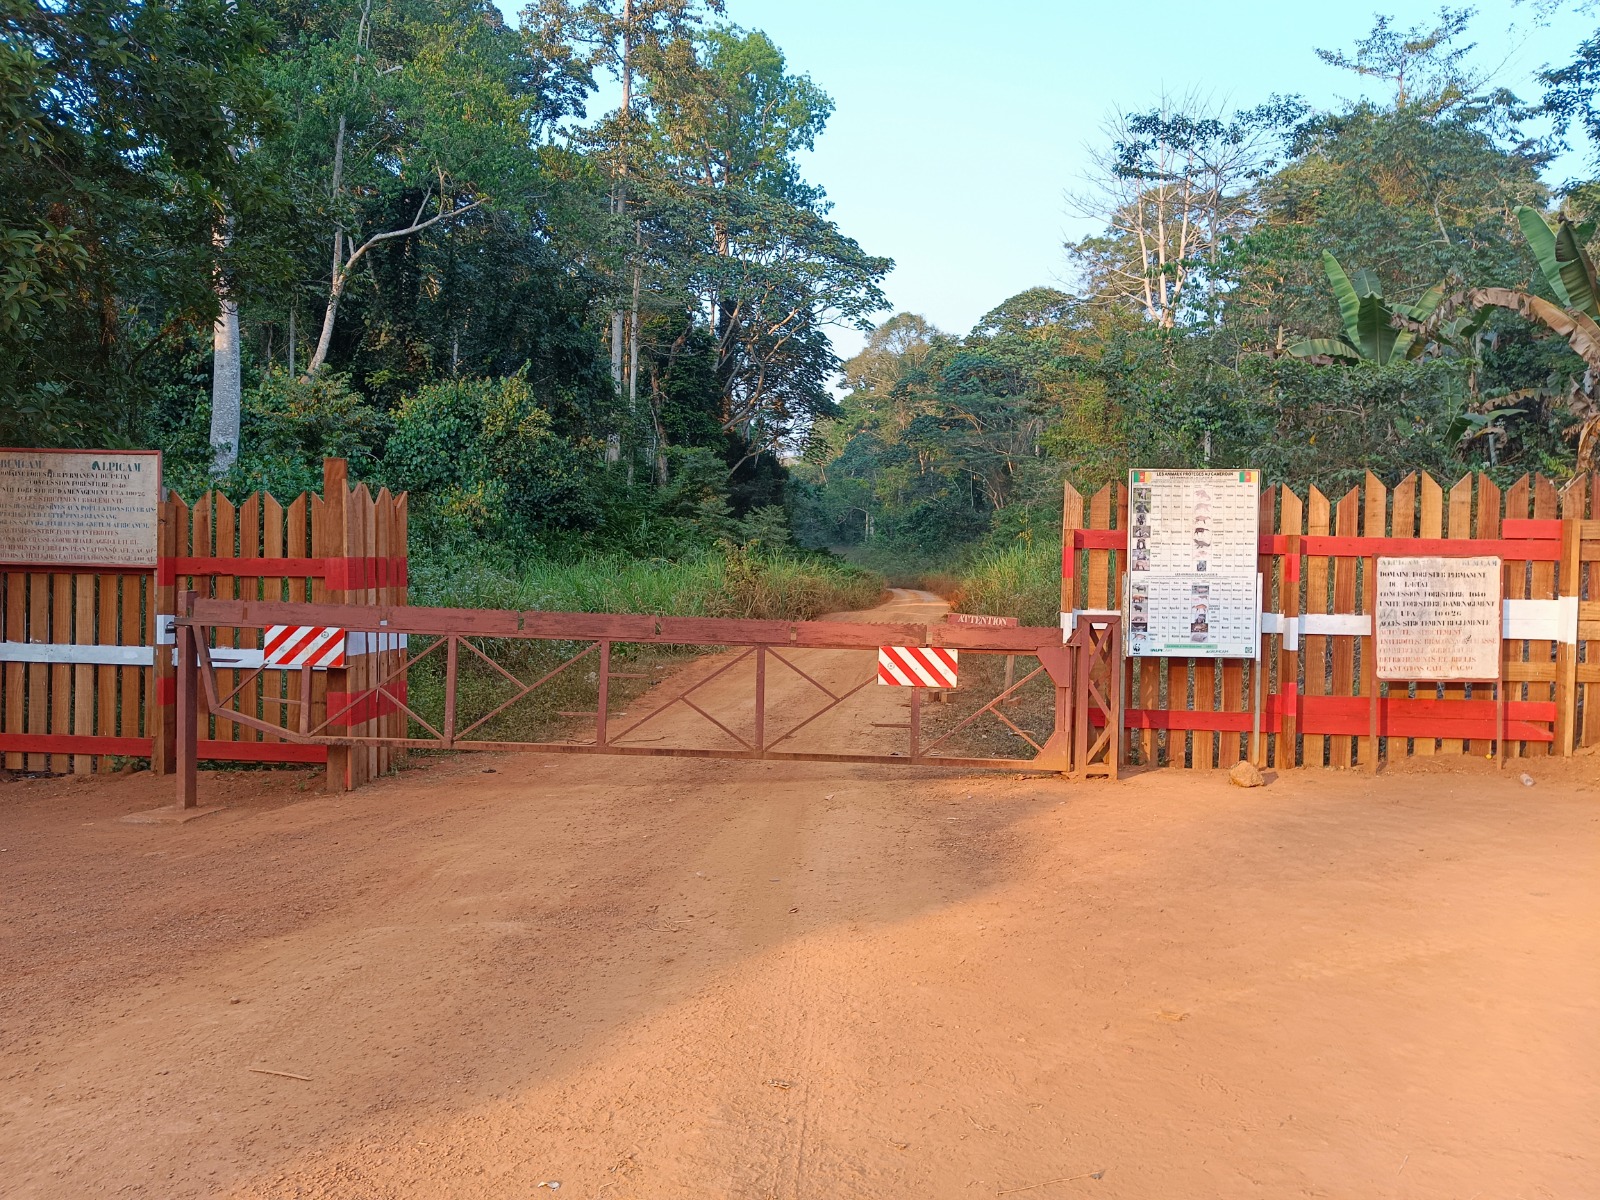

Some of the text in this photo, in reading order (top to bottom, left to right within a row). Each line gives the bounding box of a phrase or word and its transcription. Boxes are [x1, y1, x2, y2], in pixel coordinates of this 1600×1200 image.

[92, 460, 142, 473] ALPICAM
[1448, 571, 1486, 579] PERMANENT
[957, 614, 1007, 627] ATTENTION
